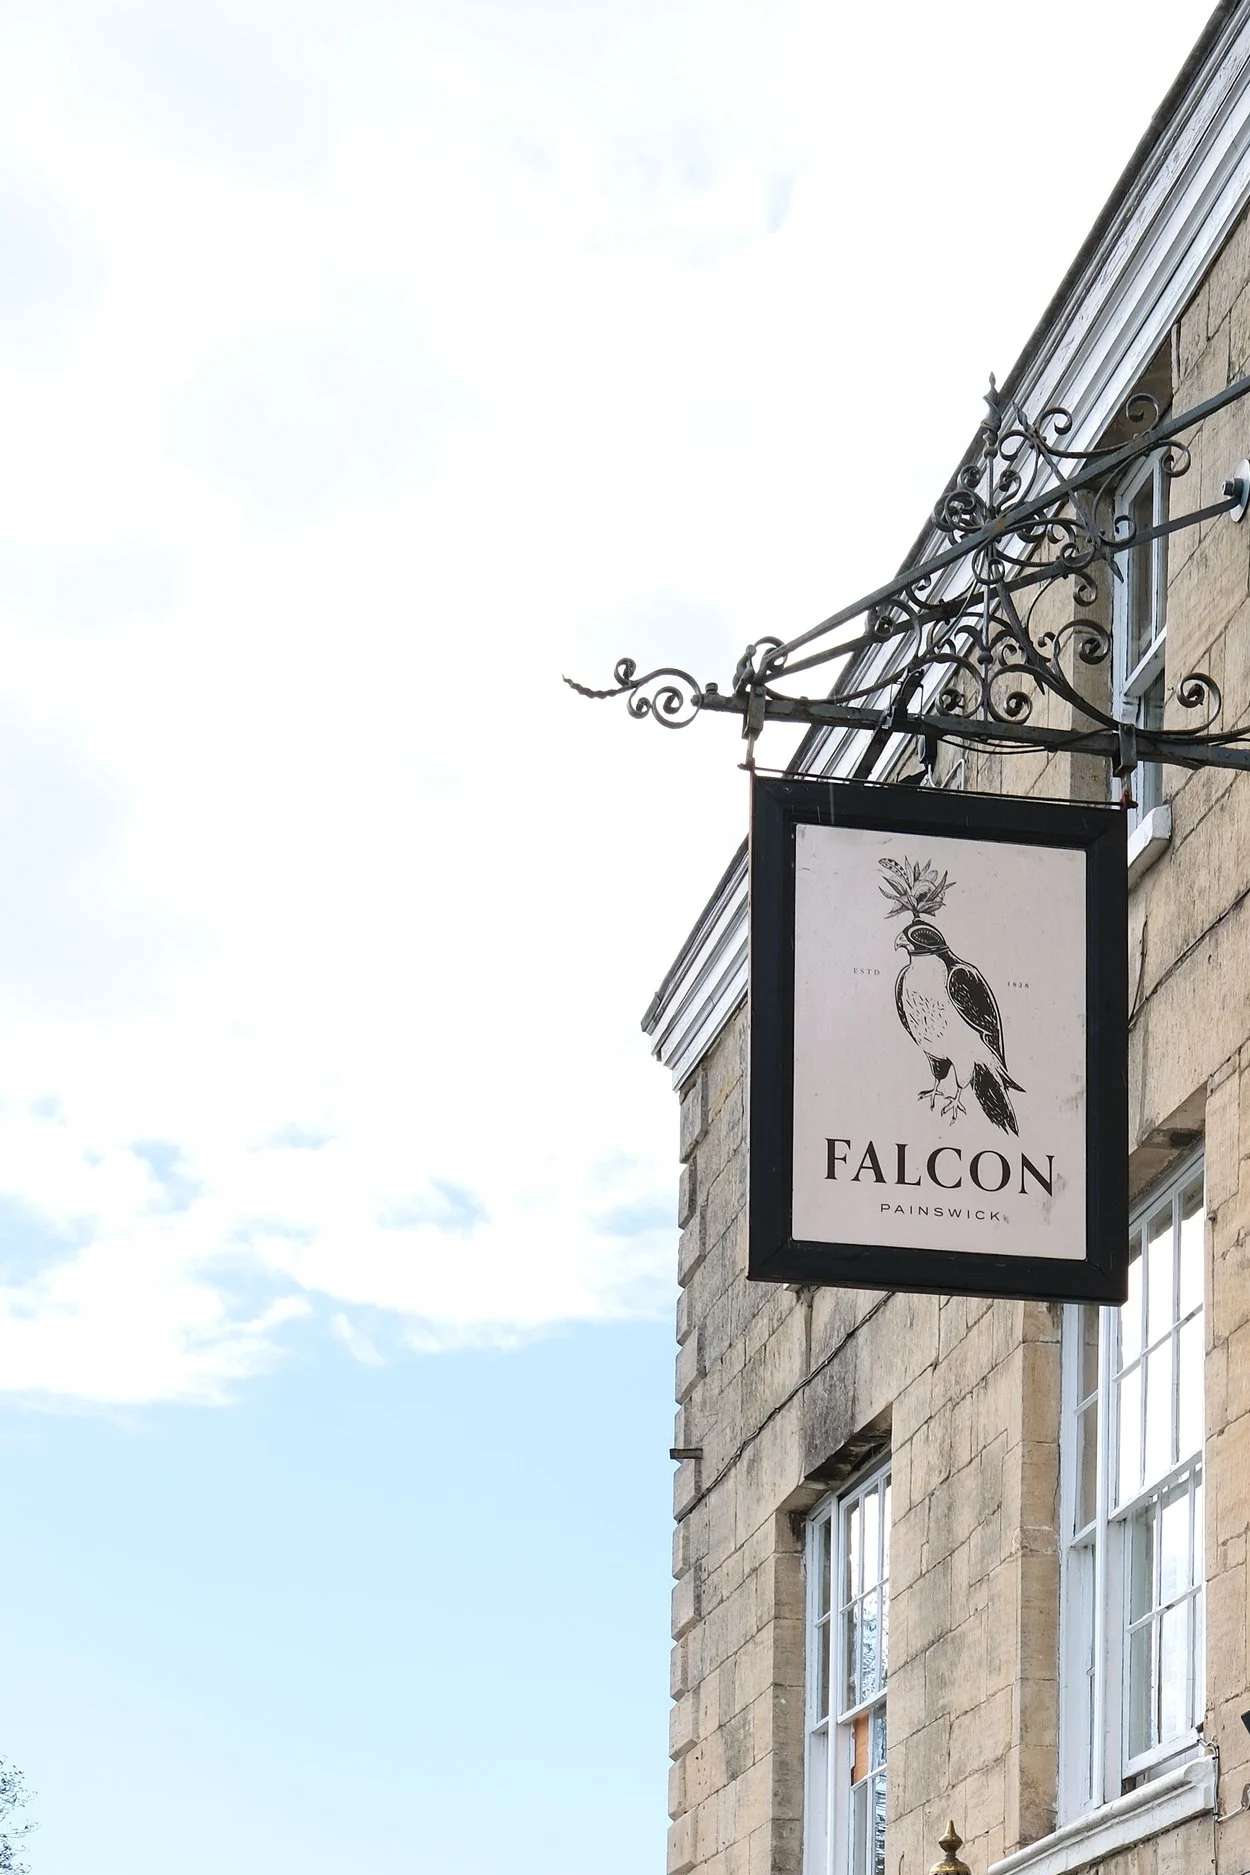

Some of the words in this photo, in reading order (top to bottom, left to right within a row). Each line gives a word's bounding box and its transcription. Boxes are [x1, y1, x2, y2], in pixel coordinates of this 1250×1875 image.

[853, 967, 881, 976] ESTD
[1007, 980, 1030, 989] 1828
[824, 1137, 1055, 1197] FALCON
[880, 1203, 1001, 1222] PAINSWICK
